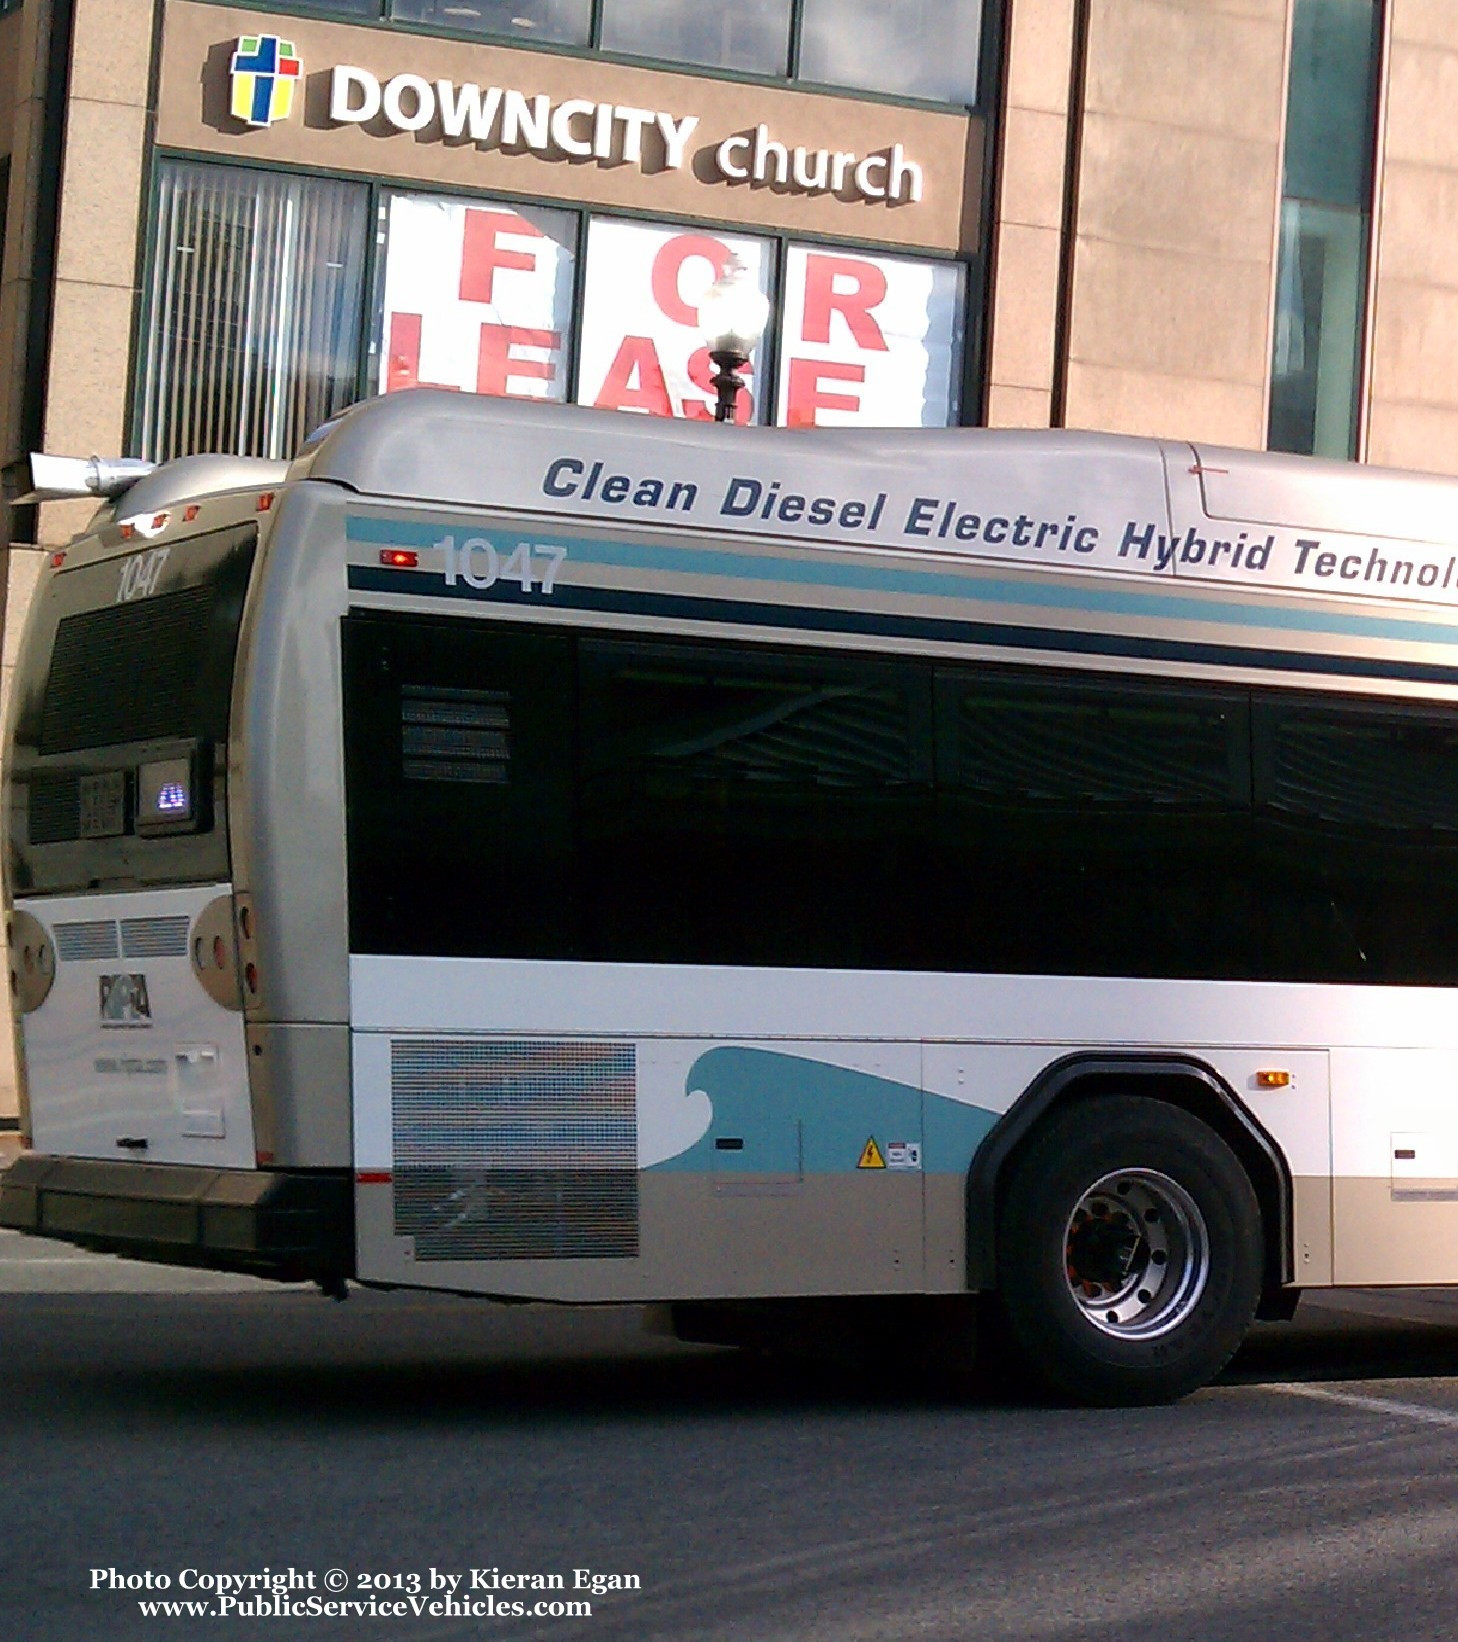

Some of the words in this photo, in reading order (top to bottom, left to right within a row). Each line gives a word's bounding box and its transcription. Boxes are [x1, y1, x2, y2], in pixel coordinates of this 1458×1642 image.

[330, 65, 699, 168] DOWNCITY
[716, 123, 923, 202] church
[458, 208, 889, 351] FOR
[386, 311, 866, 428] LEASE
[433, 534, 567, 594] 1047
[542, 457, 698, 512] Clean
[719, 477, 888, 531] Diesel
[904, 497, 1099, 554] Electric
[1117, 521, 1275, 571] Hybrid
[116, 548, 170, 603] 1047
